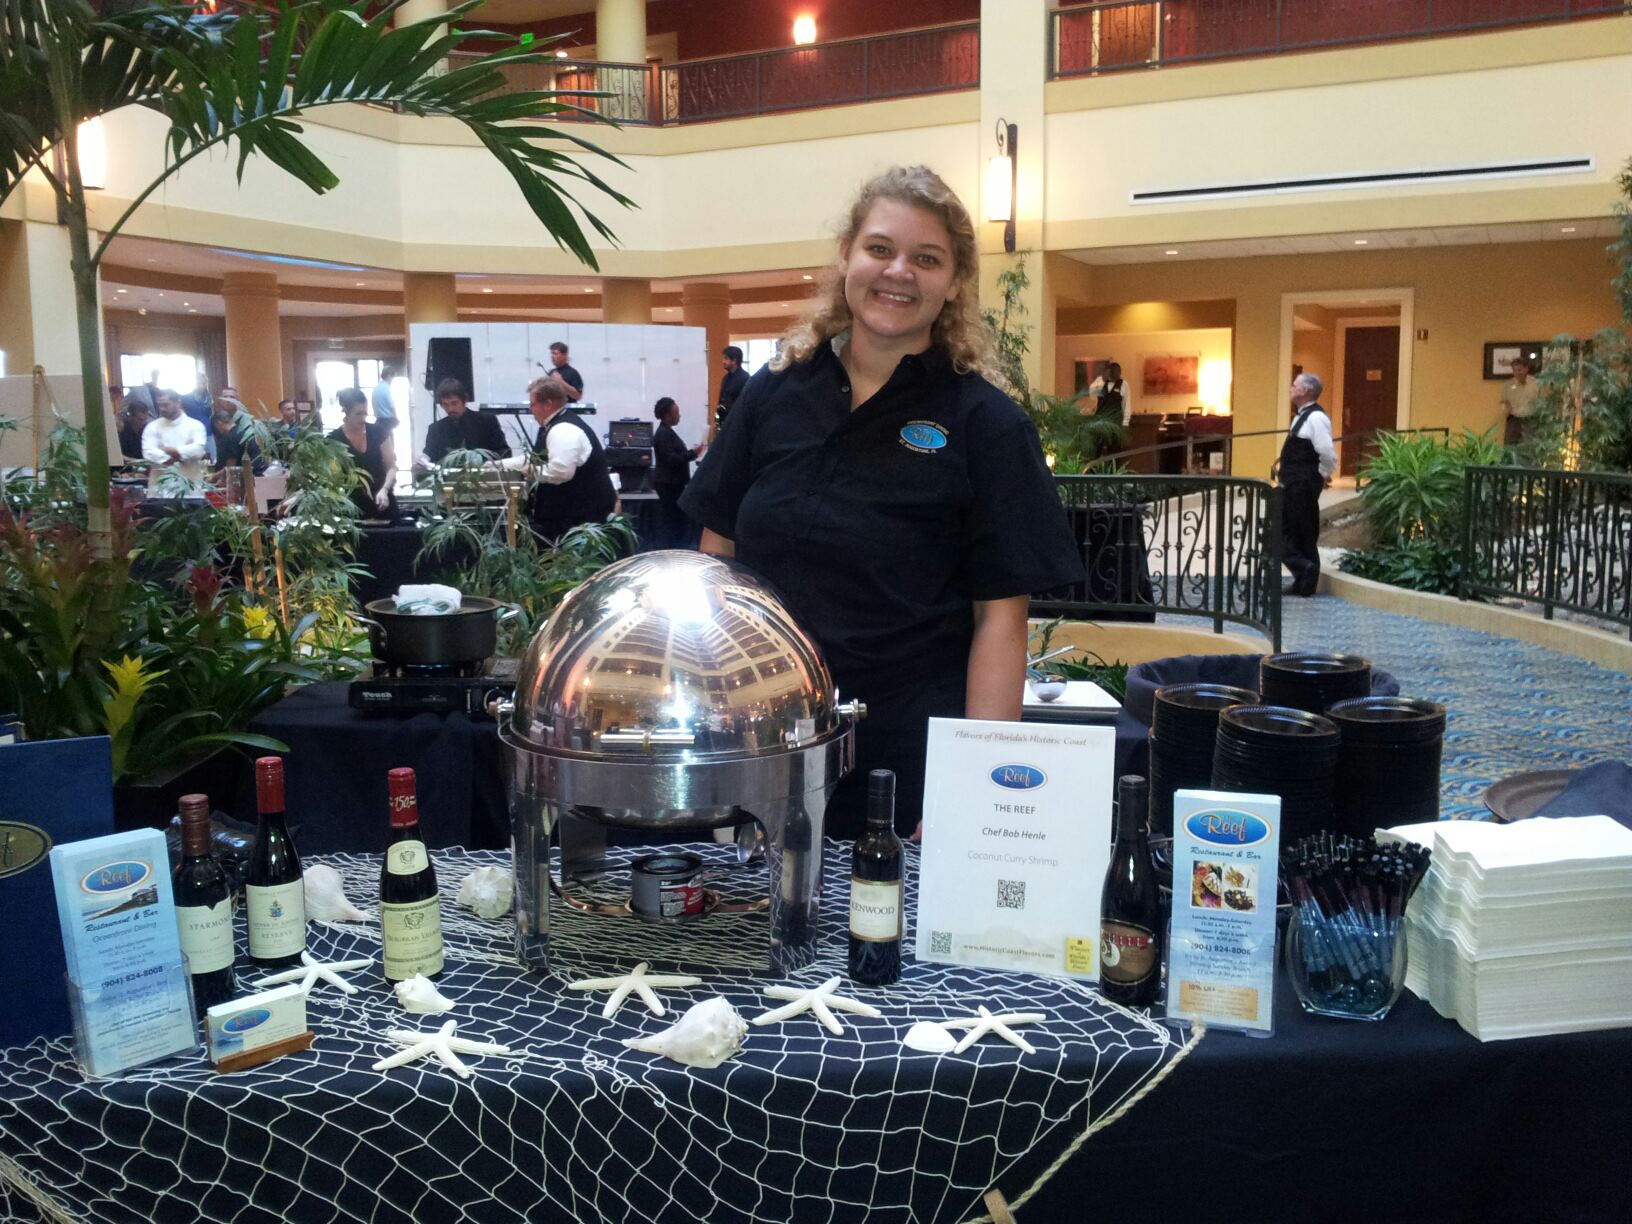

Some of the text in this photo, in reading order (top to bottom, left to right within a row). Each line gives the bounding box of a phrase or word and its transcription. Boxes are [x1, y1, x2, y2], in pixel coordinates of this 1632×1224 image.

[954, 730, 1088, 747] Flavors of Florida's Historic Coast
[999, 766, 1032, 788] Reef
[993, 803, 1037, 815] THE REEF
[981, 827, 1047, 841] Chef Bob Henle
[1198, 812, 1247, 842] Reef
[967, 850, 1059, 868] Coconut Curry Shrimp
[1190, 846, 1262, 860] Restaurant & Bar
[101, 864, 132, 887] Reef
[84, 908, 159, 933] Restaurant & Bar
